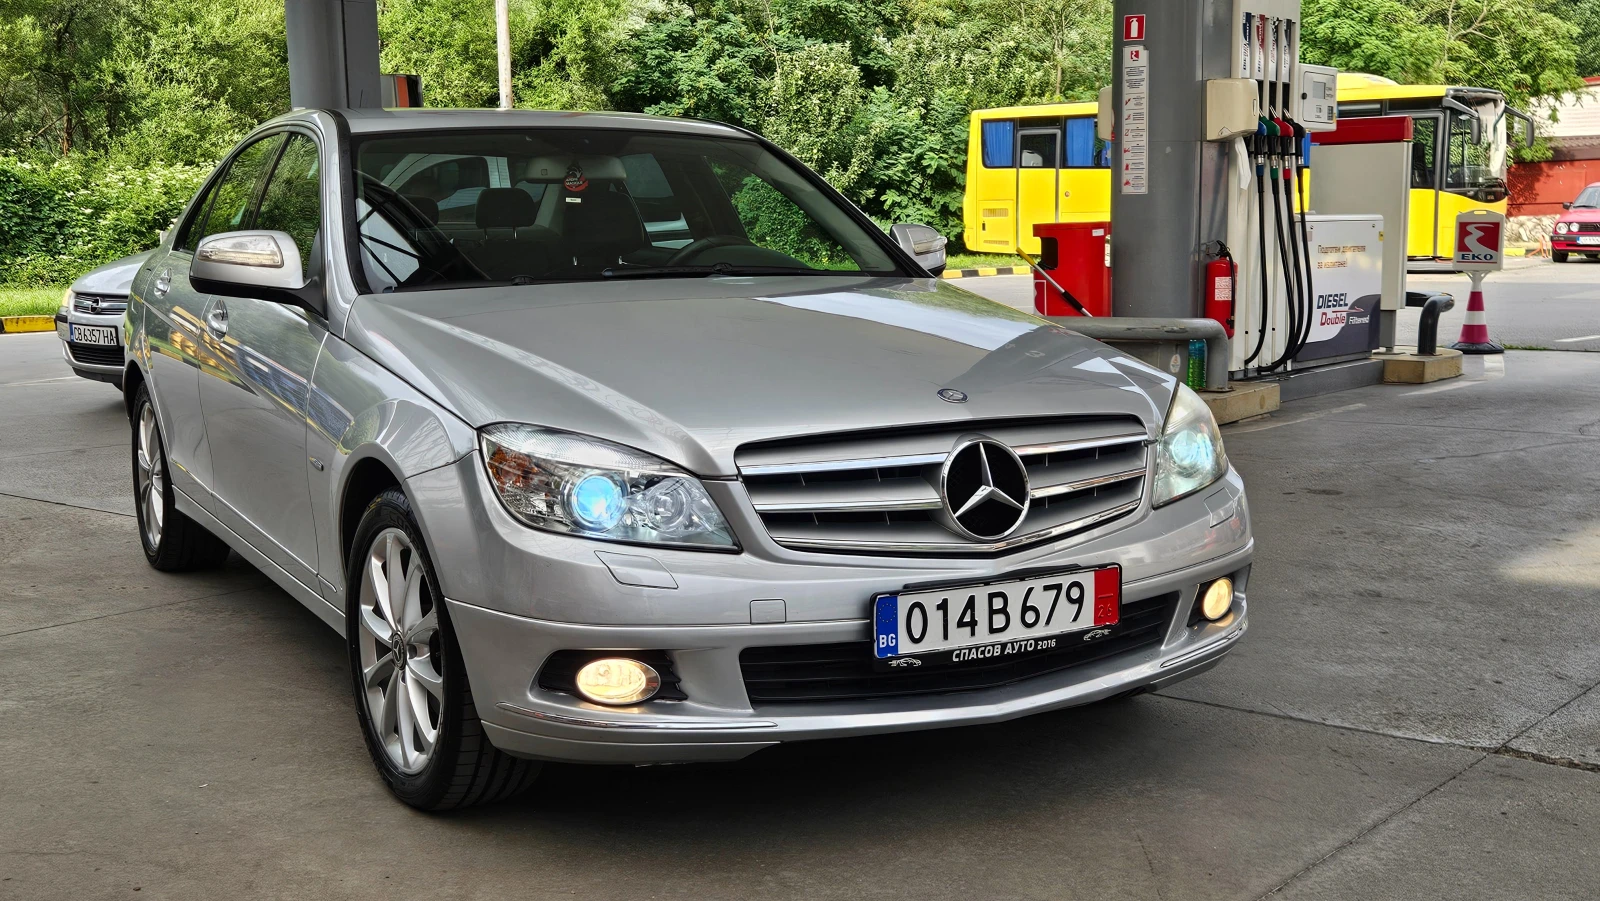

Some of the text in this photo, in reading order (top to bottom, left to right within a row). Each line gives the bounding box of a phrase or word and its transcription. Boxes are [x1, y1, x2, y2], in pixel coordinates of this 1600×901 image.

[1461, 253, 1494, 261] EKO
[1317, 293, 1348, 309] DIESEL
[1320, 312, 1370, 326] Double Filtered
[74, 327, 116, 344] CB 6357 HA
[879, 634, 896, 648] BG
[952, 639, 1056, 662] СПАСОВ АУТО 2016
